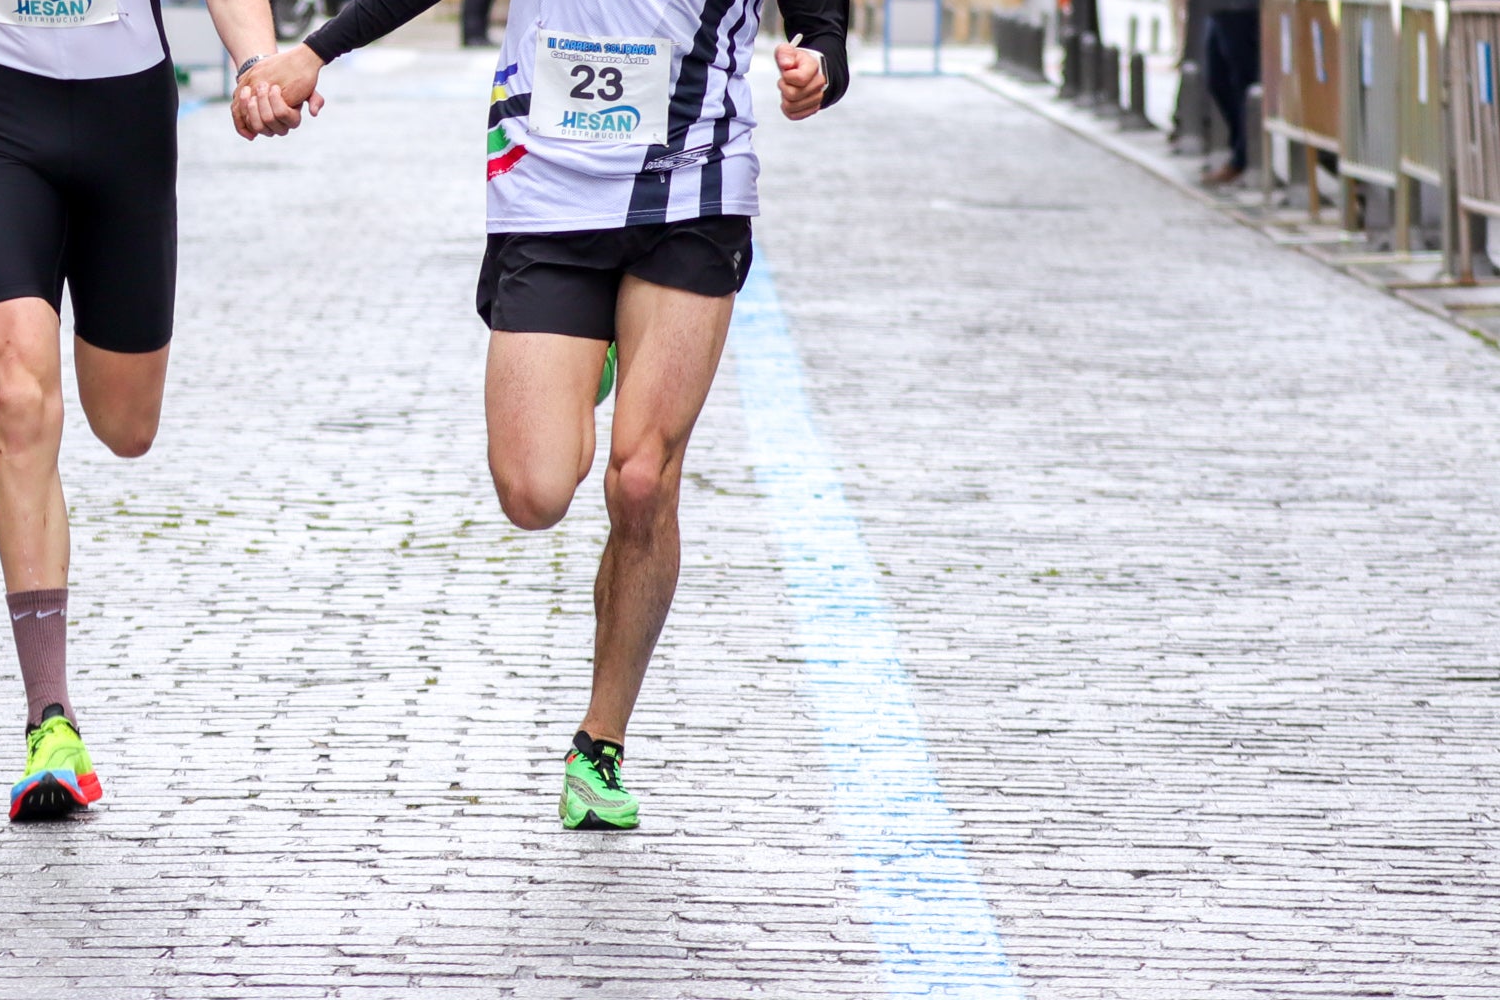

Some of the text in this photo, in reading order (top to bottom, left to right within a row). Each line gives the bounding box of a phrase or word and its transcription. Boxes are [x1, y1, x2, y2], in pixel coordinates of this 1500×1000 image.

[16, 0, 84, 16] HESAN
[547, 37, 657, 56] III CARRERA SOLIDARIA
[550, 50, 650, 65] Colegio Maestro Ávila
[569, 64, 624, 102] 23
[561, 111, 632, 132] HESAN
